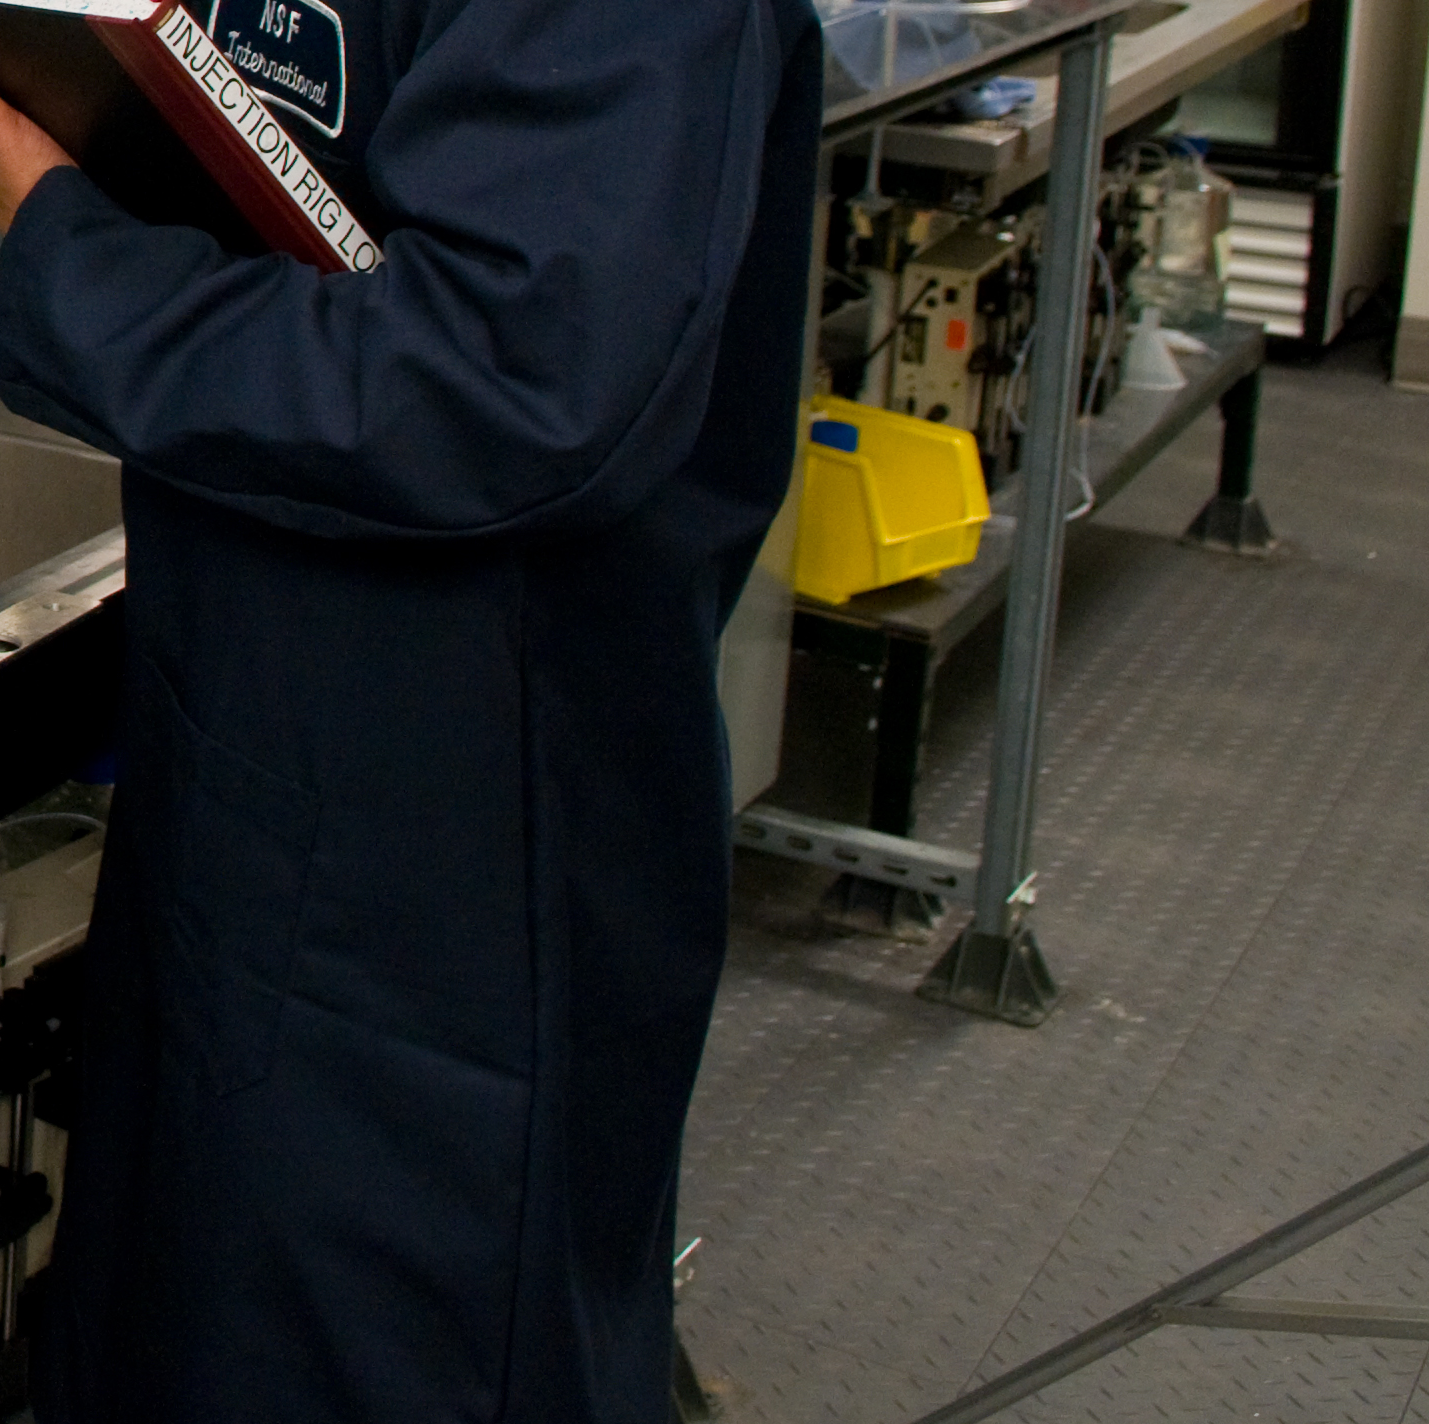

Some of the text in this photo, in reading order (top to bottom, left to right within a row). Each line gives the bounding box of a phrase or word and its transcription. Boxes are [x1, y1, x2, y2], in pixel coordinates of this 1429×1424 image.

[166, 14, 377, 273] INJECTION RIG LO
[223, 30, 328, 108] International
